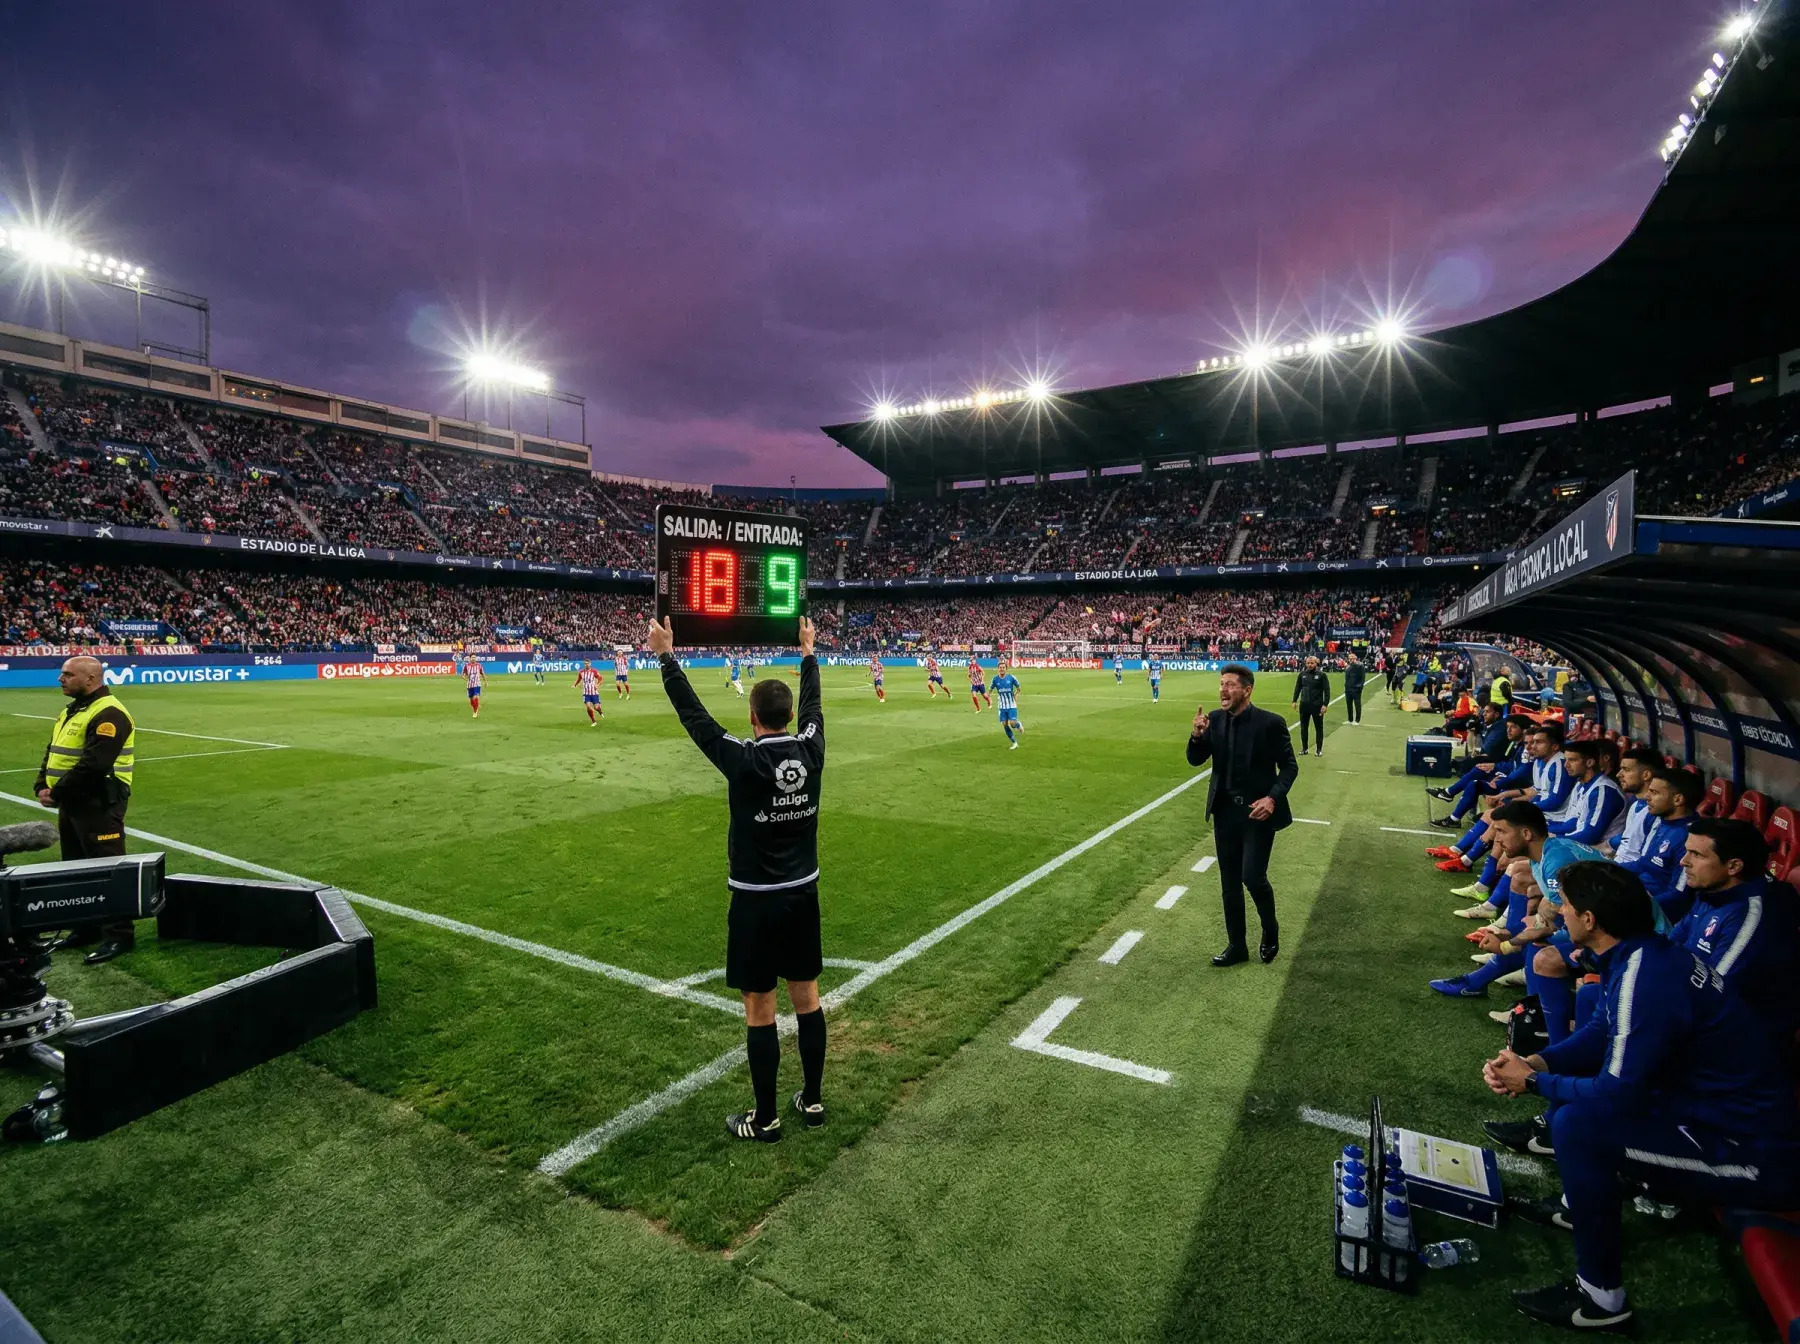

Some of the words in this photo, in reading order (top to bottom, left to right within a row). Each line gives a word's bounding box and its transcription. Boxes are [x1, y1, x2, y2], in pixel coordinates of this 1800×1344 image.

[664, 515, 722, 539] SALIDA:
[735, 521, 803, 546] ENTRADA:
[240, 538, 297, 553] ESTADIO
[299, 543, 317, 555] DE
[319, 545, 336, 556] LA
[338, 547, 366, 558] LIGA
[1553, 519, 1588, 573] LOCAL
[692, 551, 734, 612] 18
[769, 556, 796, 614] 9
[1075, 571, 1110, 580] ESTADIO
[1111, 570, 1123, 579] DE
[1125, 570, 1136, 578] LA
[1138, 569, 1159, 578] LIGA
[338, 663, 379, 678] LaLiga
[394, 662, 452, 676] Santander
[1162, 660, 1209, 671] movistar
[141, 667, 232, 683] movistar
[773, 794, 808, 806] LaLiga
[770, 805, 817, 822] Santander
[46, 896, 97, 908] movistar
